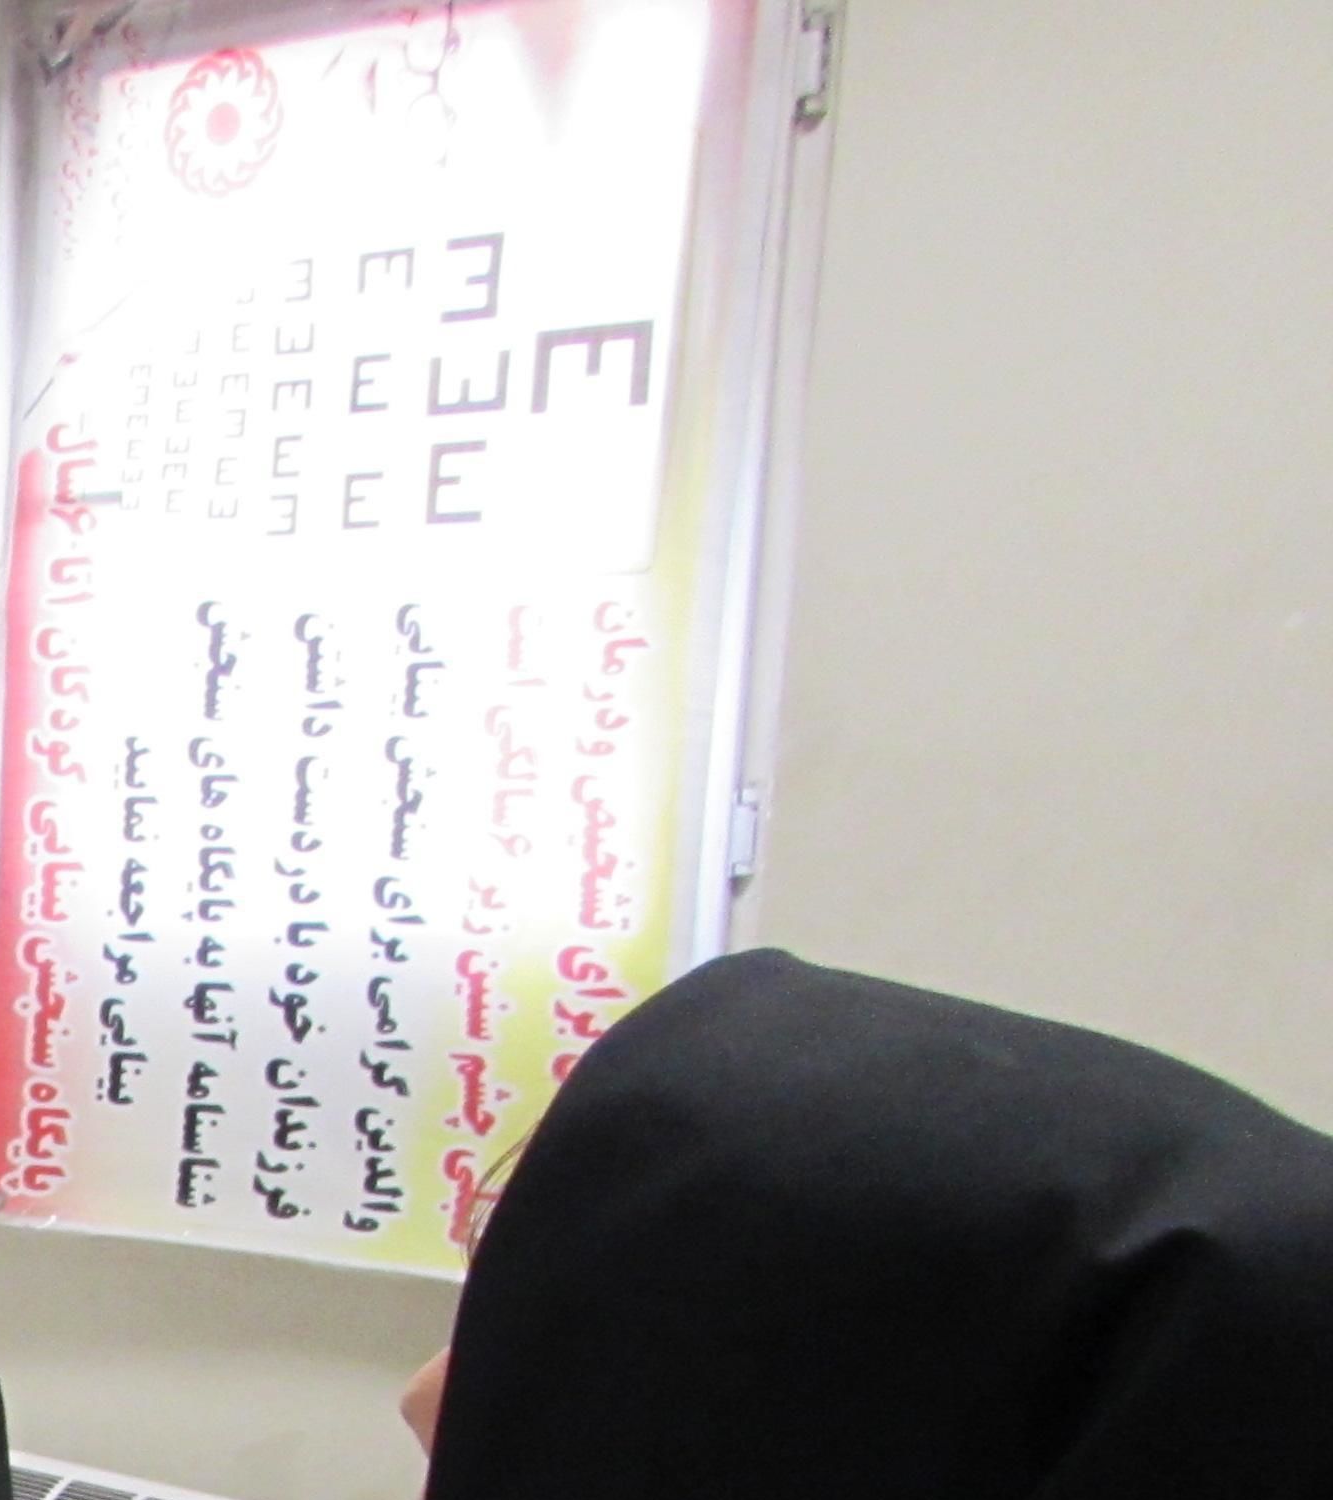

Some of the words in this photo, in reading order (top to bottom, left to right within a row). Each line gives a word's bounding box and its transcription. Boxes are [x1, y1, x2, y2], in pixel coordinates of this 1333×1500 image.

[194, 600, 252, 721] سنجش
[293, 612, 346, 737] داشتن
[389, 603, 446, 718] بینایی
[505, 604, 548, 685] است
[31, 626, 94, 784] کودکان
[113, 735, 160, 843] نمایید
[188, 736, 240, 809] های
[382, 735, 438, 861] سنجش
[26, 800, 85, 923] بینایی
[181, 823, 237, 922] پایگاه
[462, 876, 511, 936] زیر
[567, 774, 635, 930] تشخیص
[103, 857, 157, 985] مراجعه
[183, 935, 226, 968] به
[273, 920, 331, 948] با
[369, 875, 427, 963] برای
[20, 935, 80, 1069] سنجش
[96, 997, 149, 1105] بینایی
[183, 982, 238, 1051] آنها
[268, 961, 326, 1044] خود
[359, 975, 414, 1098] گرامی
[454, 949, 509, 1041] سنین
[6, 1080, 72, 1192] پایگاه
[175, 1060, 227, 1208] شناسنامه
[252, 1057, 322, 1220] فرزندان
[444, 1053, 513, 1137] چشم
[343, 1106, 404, 1232] والدین
